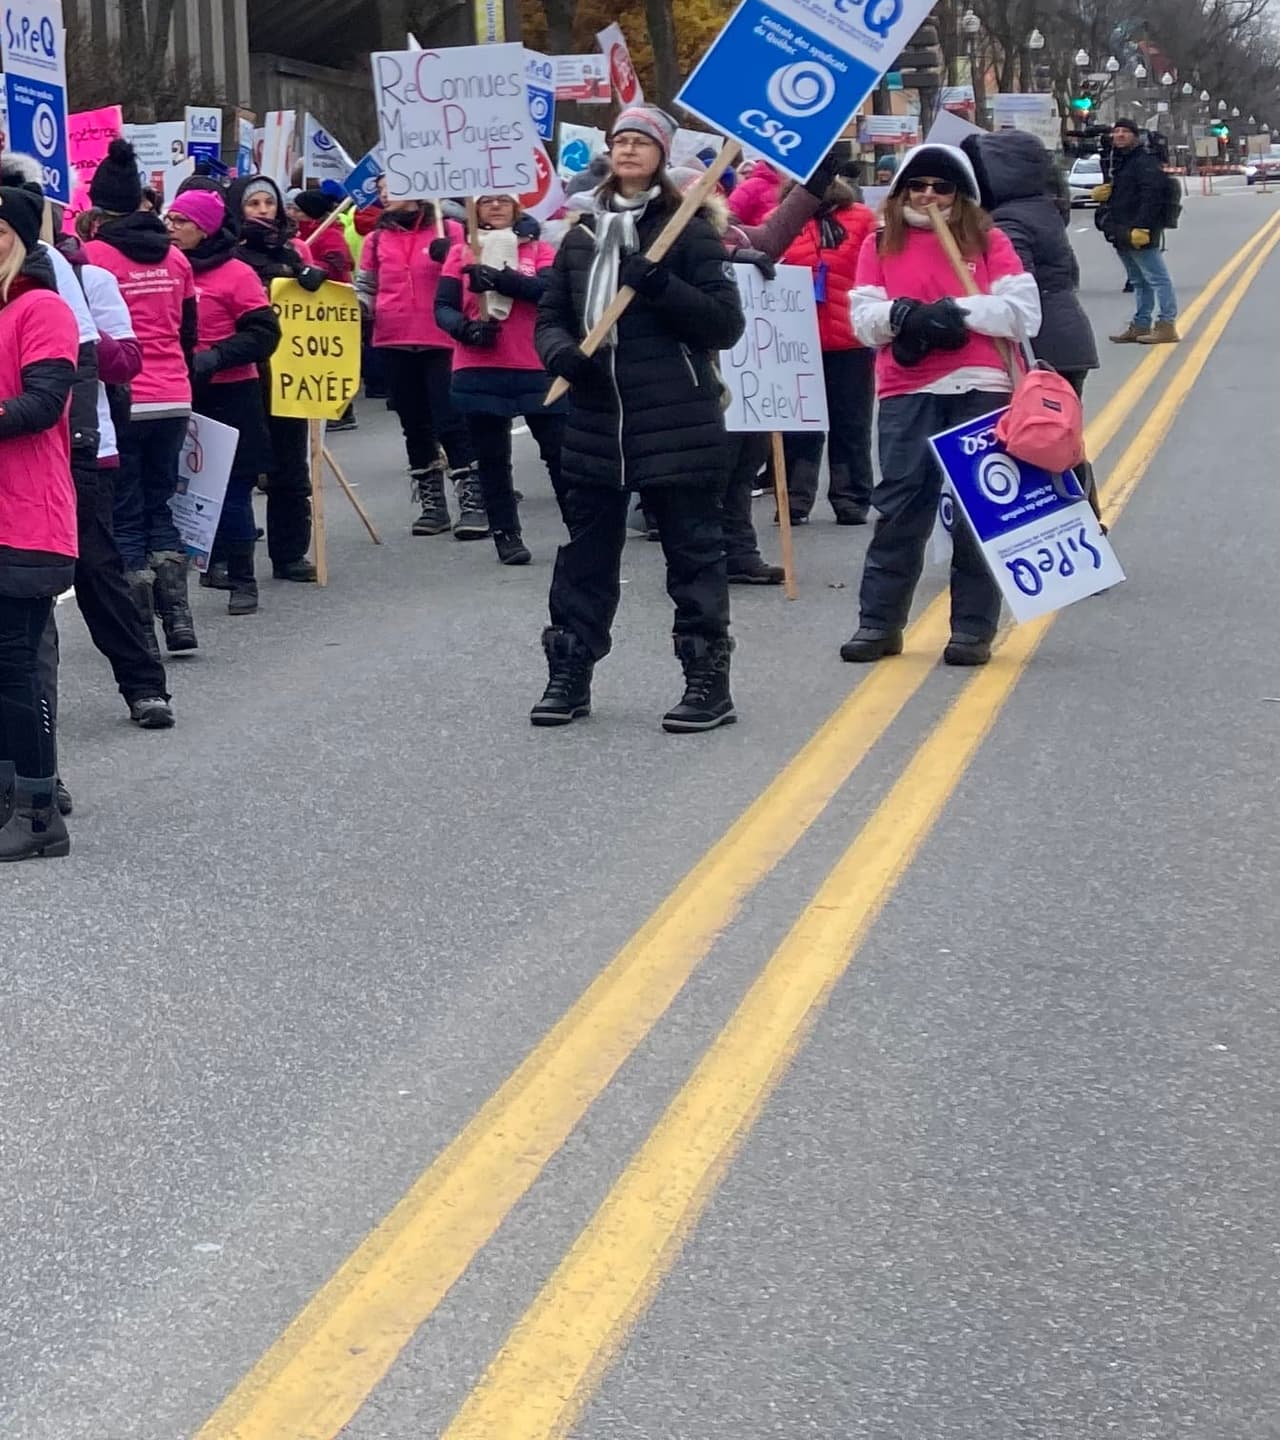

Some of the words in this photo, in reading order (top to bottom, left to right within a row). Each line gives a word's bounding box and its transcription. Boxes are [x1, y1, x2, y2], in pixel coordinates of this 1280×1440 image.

[6, 9, 56, 58] SiPeQ
[377, 52, 522, 107] ReConnues
[380, 109, 442, 150] Mieux
[443, 104, 524, 152] Payées
[739, 109, 802, 157] CSQ
[387, 146, 530, 196] SoutenuEs
[292, 336, 344, 357] SOUS
[280, 371, 354, 402] PAYÉE
[740, 370, 821, 424] RelèvE
[960, 428, 1000, 455] CSQ
[1006, 528, 1102, 596] SiPeQ
